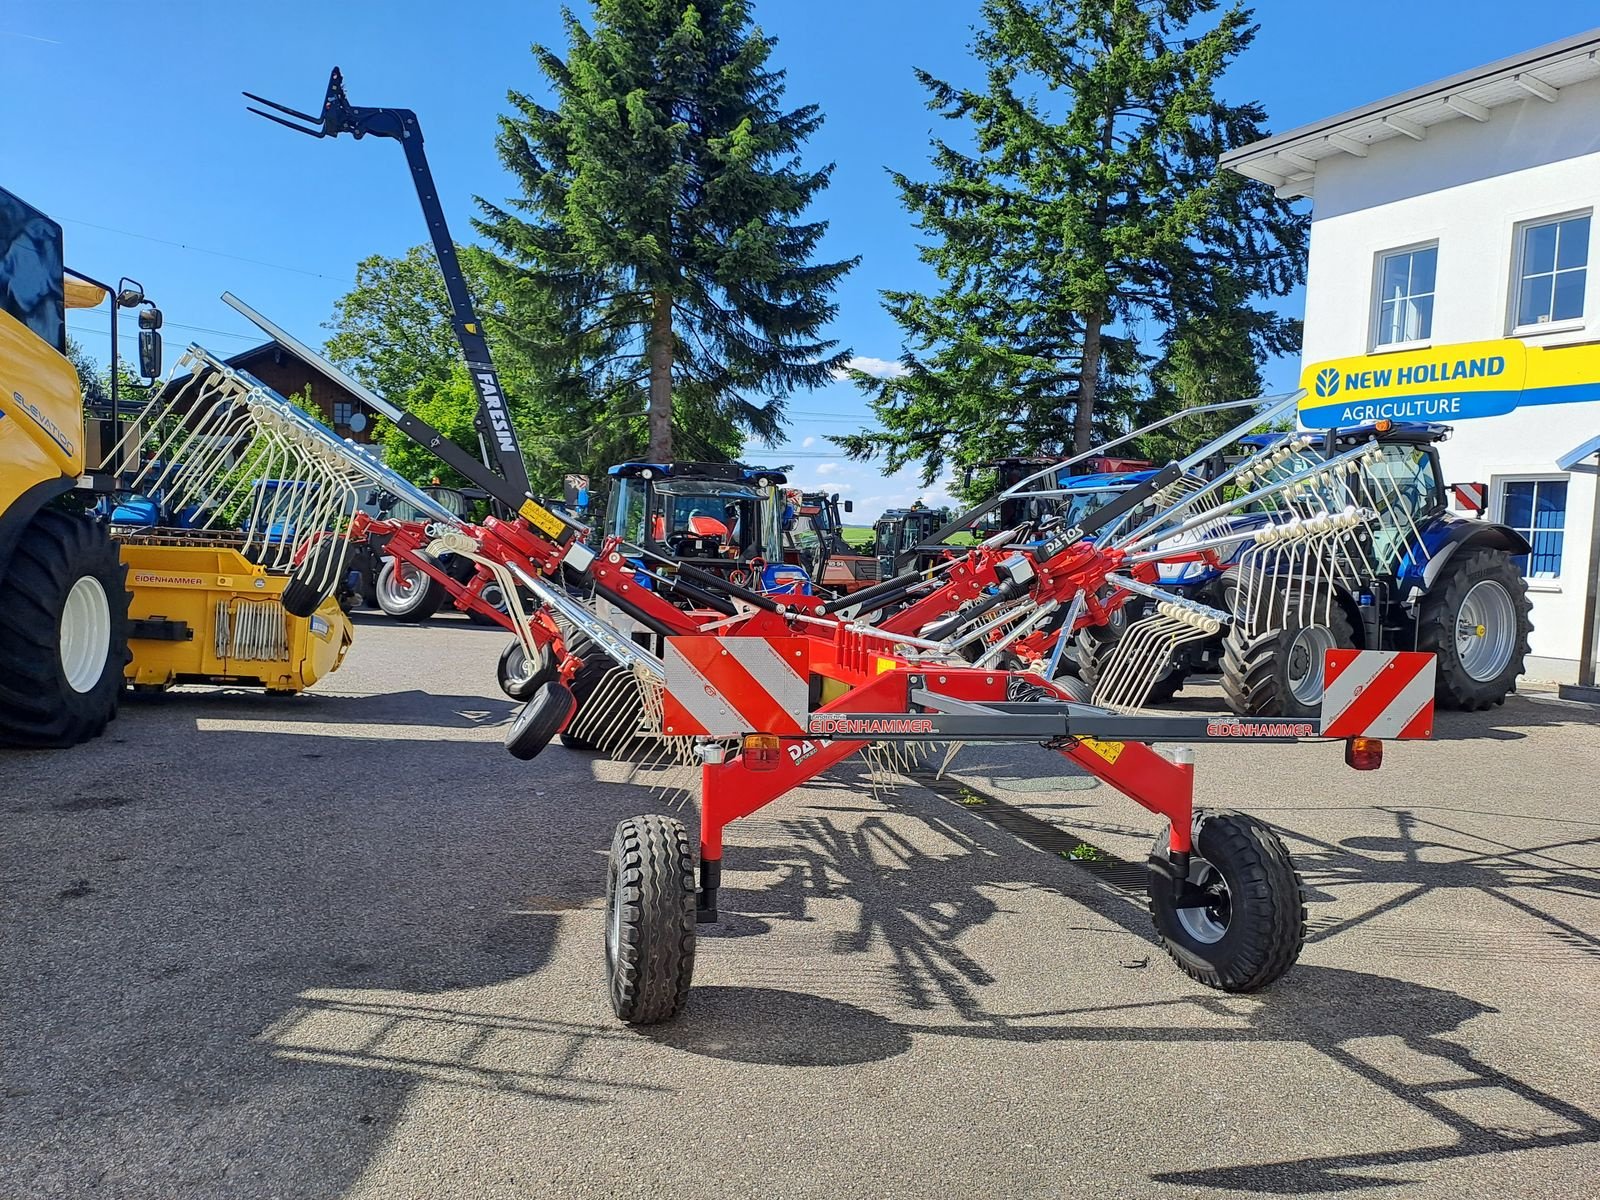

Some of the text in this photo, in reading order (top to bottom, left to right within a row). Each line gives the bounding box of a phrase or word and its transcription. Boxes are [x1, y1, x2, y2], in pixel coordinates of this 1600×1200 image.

[1345, 356, 1505, 391] NEW HOLLAND
[476, 373, 516, 452] FARESIN
[1341, 398, 1461, 421] AGRICULTURE
[13, 391, 75, 455] ELEVATION
[135, 575, 202, 585] EIDENHAMMER
[809, 719, 933, 733] EIDENHAMMER
[1207, 723, 1313, 737] EIDENHAMMER
